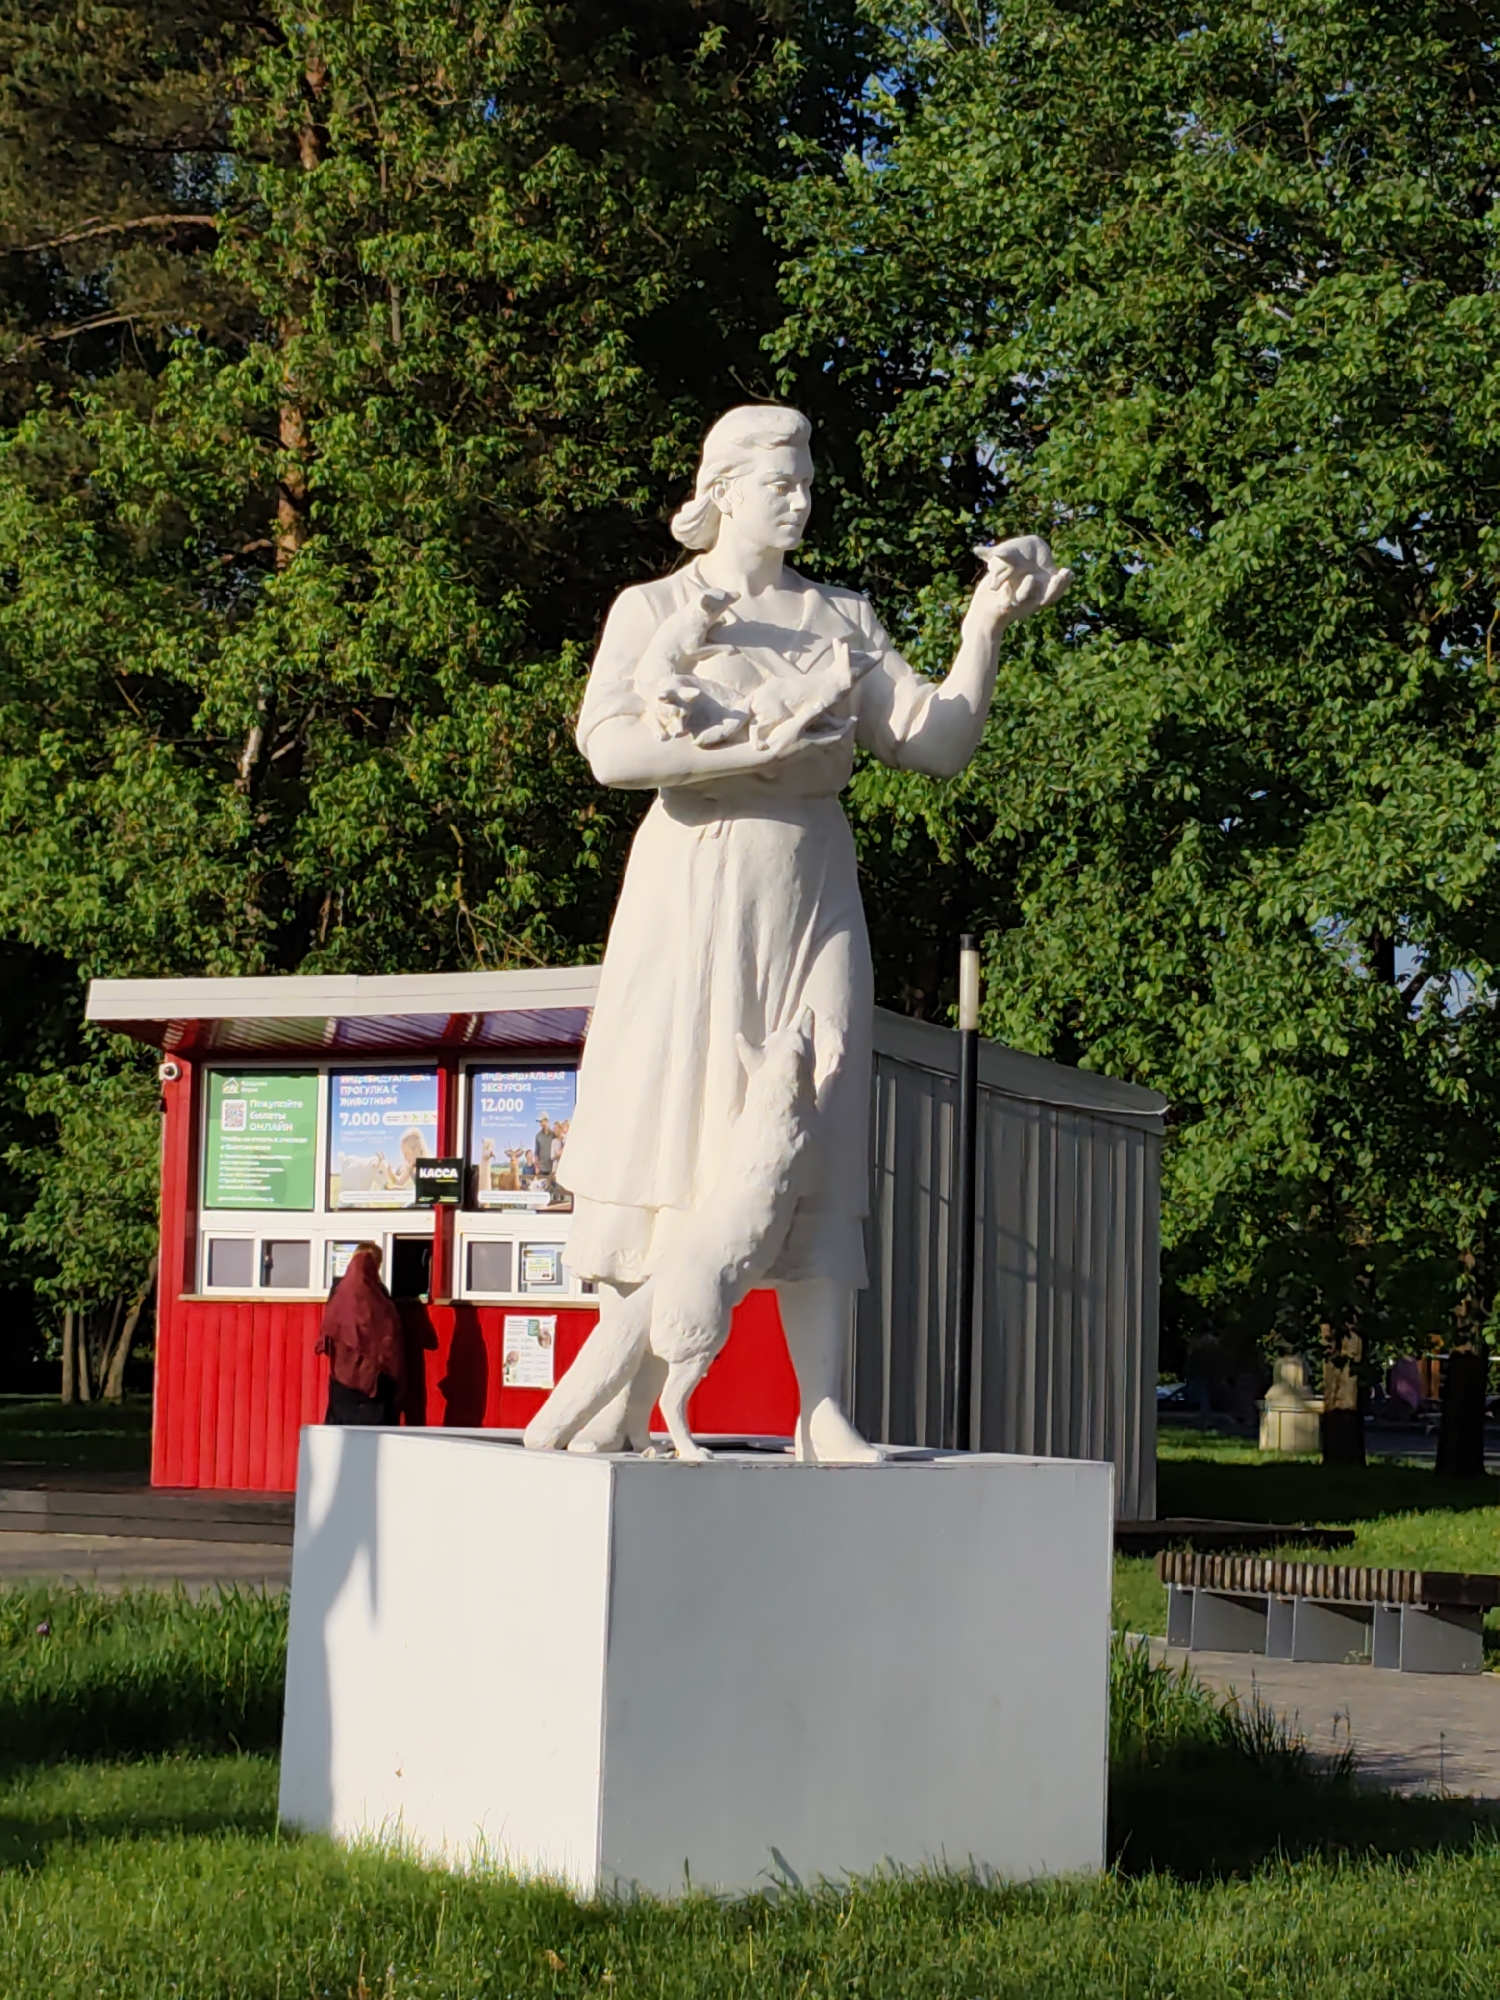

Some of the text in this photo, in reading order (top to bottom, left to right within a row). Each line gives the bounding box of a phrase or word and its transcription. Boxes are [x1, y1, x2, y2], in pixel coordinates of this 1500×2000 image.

[340, 1085, 390, 1095] ПРОГУЛКА
[250, 1099, 303, 1109] Покупайте
[481, 1098, 524, 1112] 12.000
[250, 1111, 286, 1120] билеты
[339, 1111, 380, 1126] 7.000
[250, 1121, 293, 1131] ОНЛАЙН
[419, 1167, 459, 1178] КАССА
